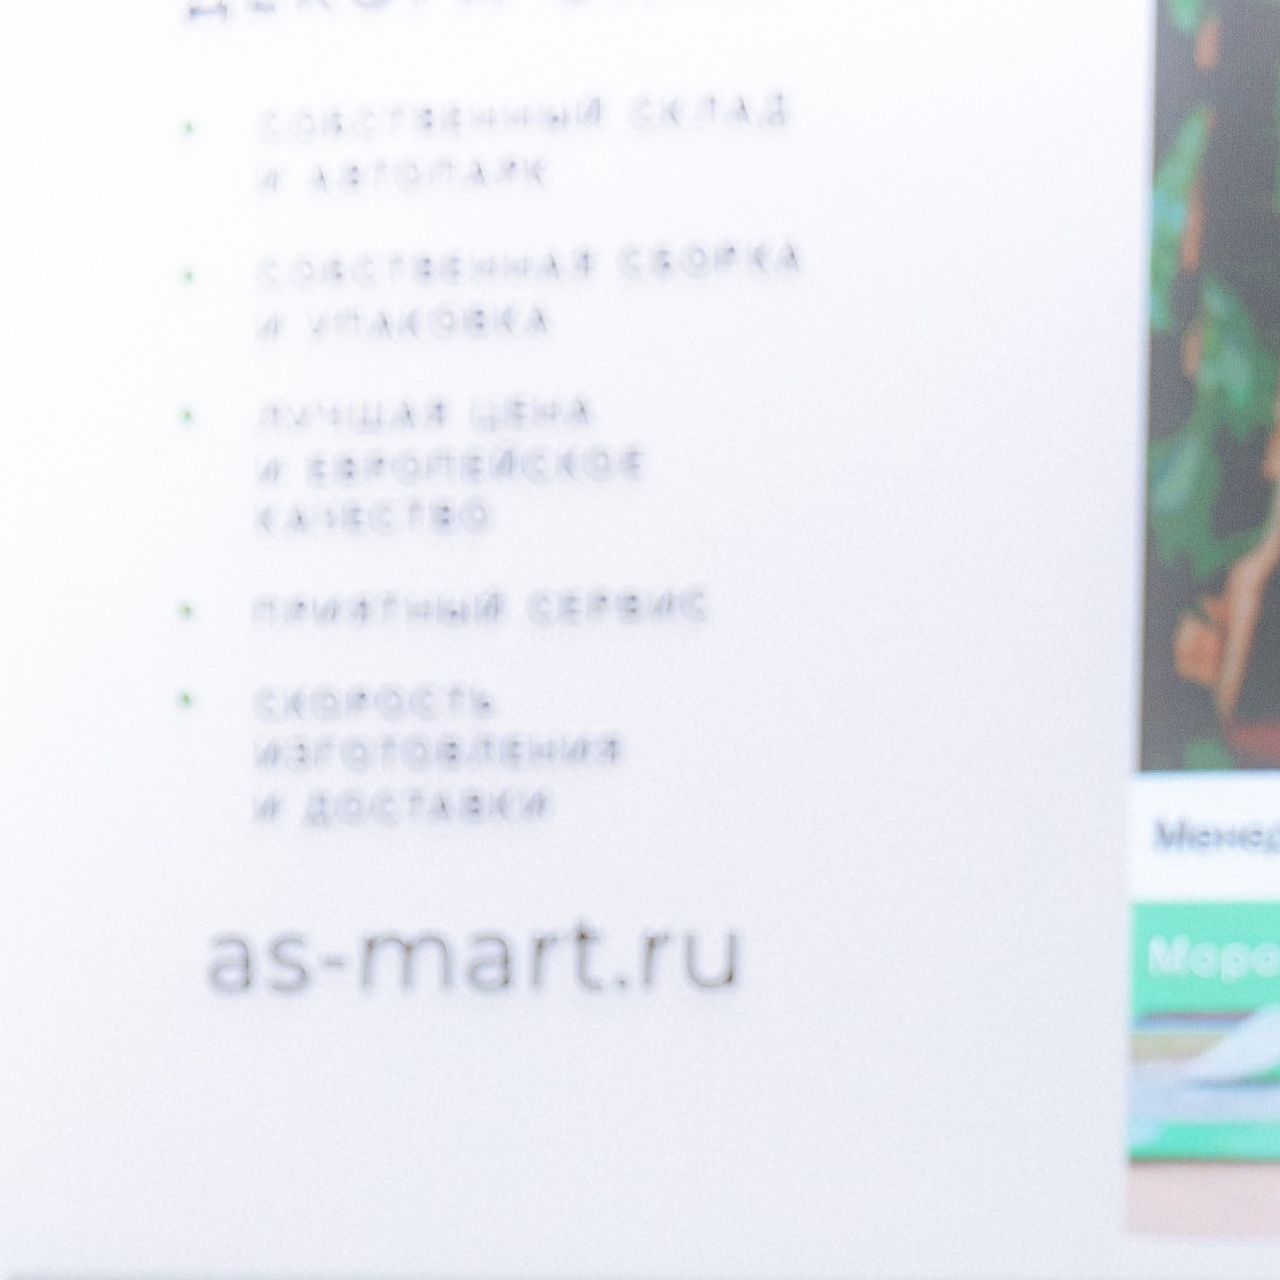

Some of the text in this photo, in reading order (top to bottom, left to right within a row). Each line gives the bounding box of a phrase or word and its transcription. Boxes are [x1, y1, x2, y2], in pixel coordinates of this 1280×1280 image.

[256, 93, 790, 139] СОБСТВЕННЫЙ СКЛАД
[257, 158, 546, 192] И АВТОПАРК
[256, 242, 801, 287] СОБСТВЕННАЯ СБОРКА
[257, 307, 547, 340] И УПАКОВКА
[256, 397, 593, 434] ЛУЧШАЯ ЦЕНА
[257, 443, 643, 485] И ЕВРОПЕЙСКОЕ
[256, 500, 493, 535] КАЧЕСТВО
[253, 588, 708, 625] ПРИЯТНЫЙ СЕРВИС
[253, 685, 495, 720] СКОРОСТЬ
[253, 733, 625, 771] ИЗГОТОВЛЕНИЯ
[253, 789, 550, 828] И ДОСТАВКИ
[208, 919, 741, 995] as-mart.ru
